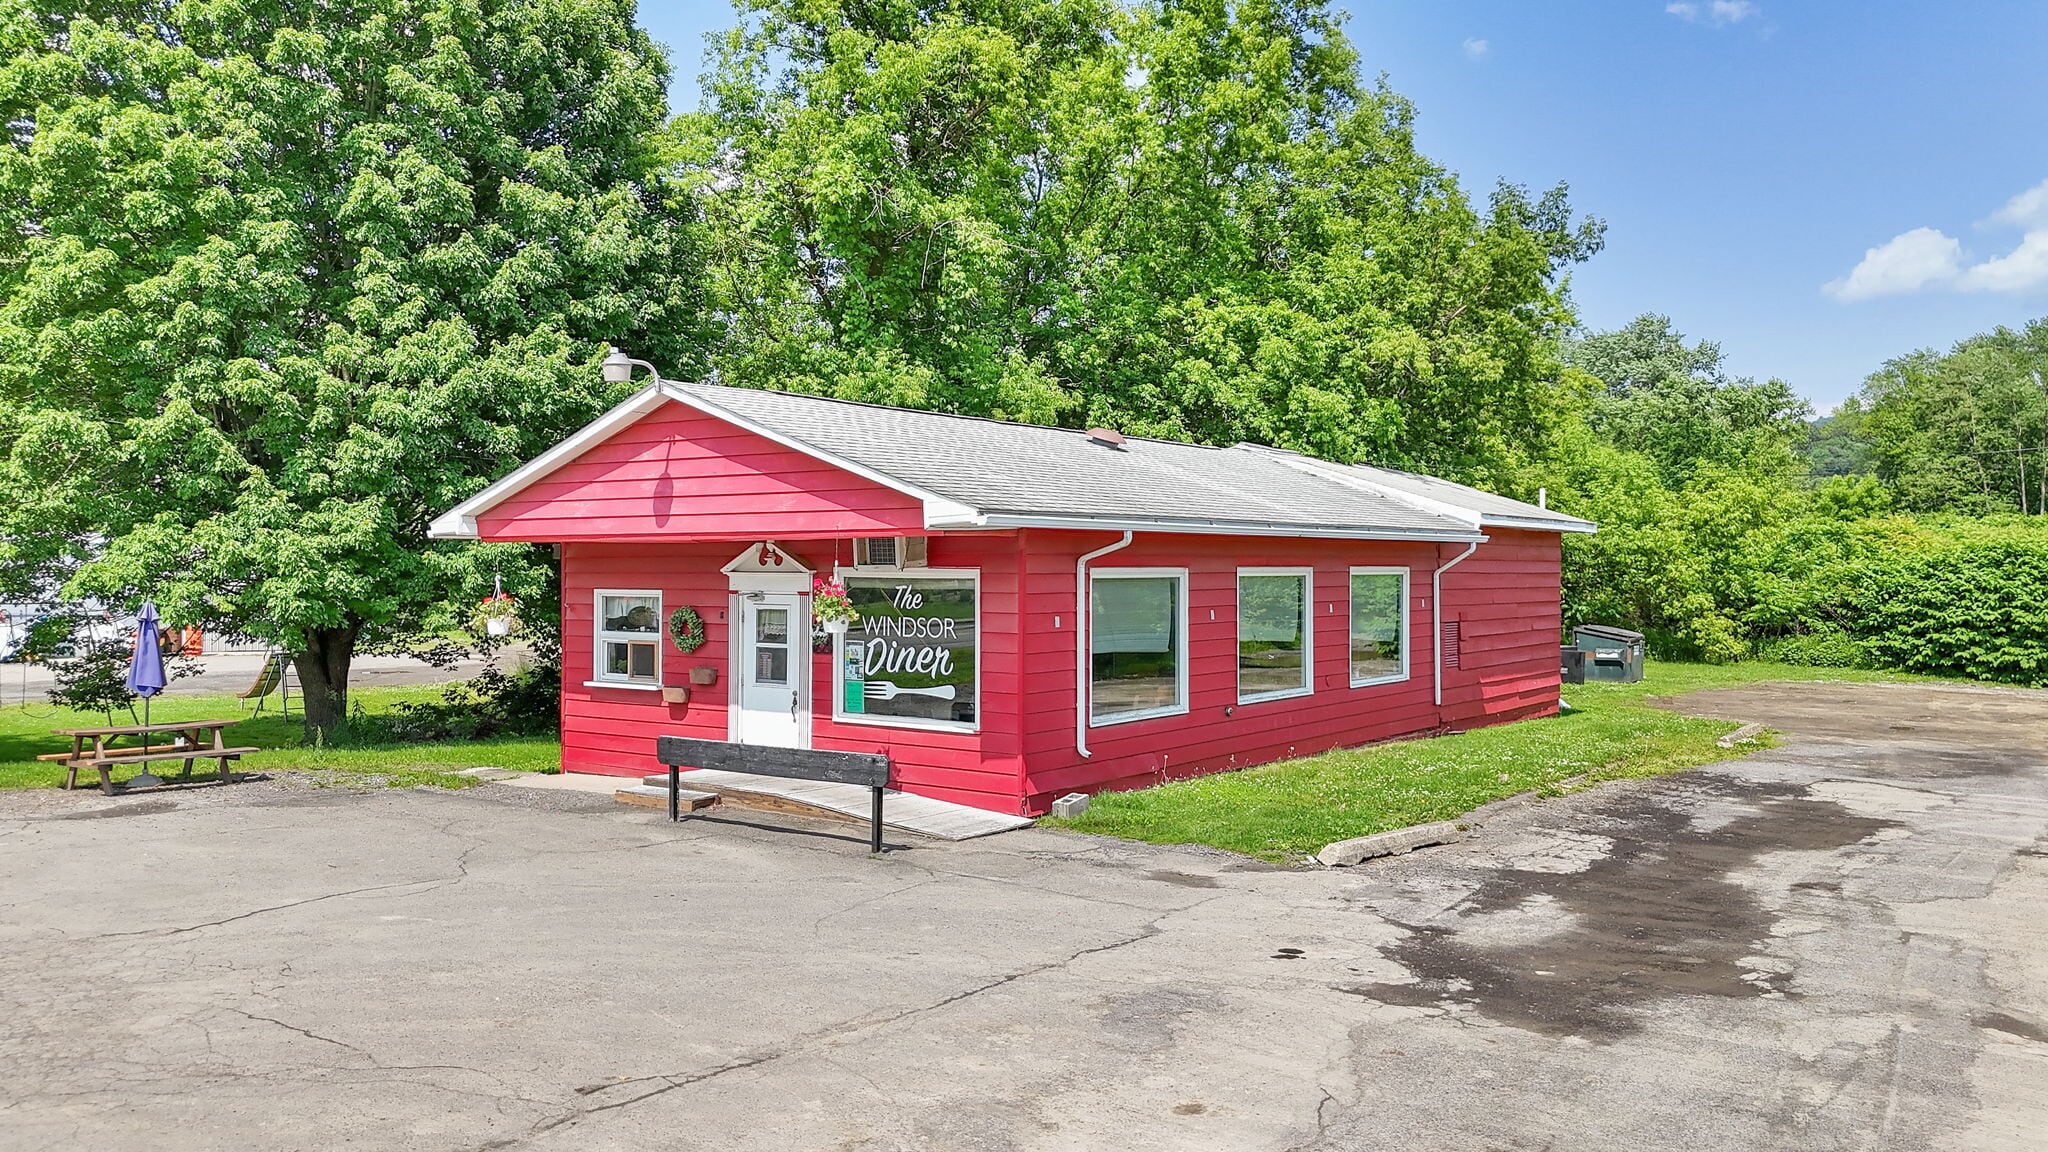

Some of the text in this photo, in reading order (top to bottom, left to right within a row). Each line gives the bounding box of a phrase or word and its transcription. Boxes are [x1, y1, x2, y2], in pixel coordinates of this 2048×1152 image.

[893, 584, 924, 610] The
[862, 615, 957, 640] WINDSOR
[864, 637, 954, 680] Diner
